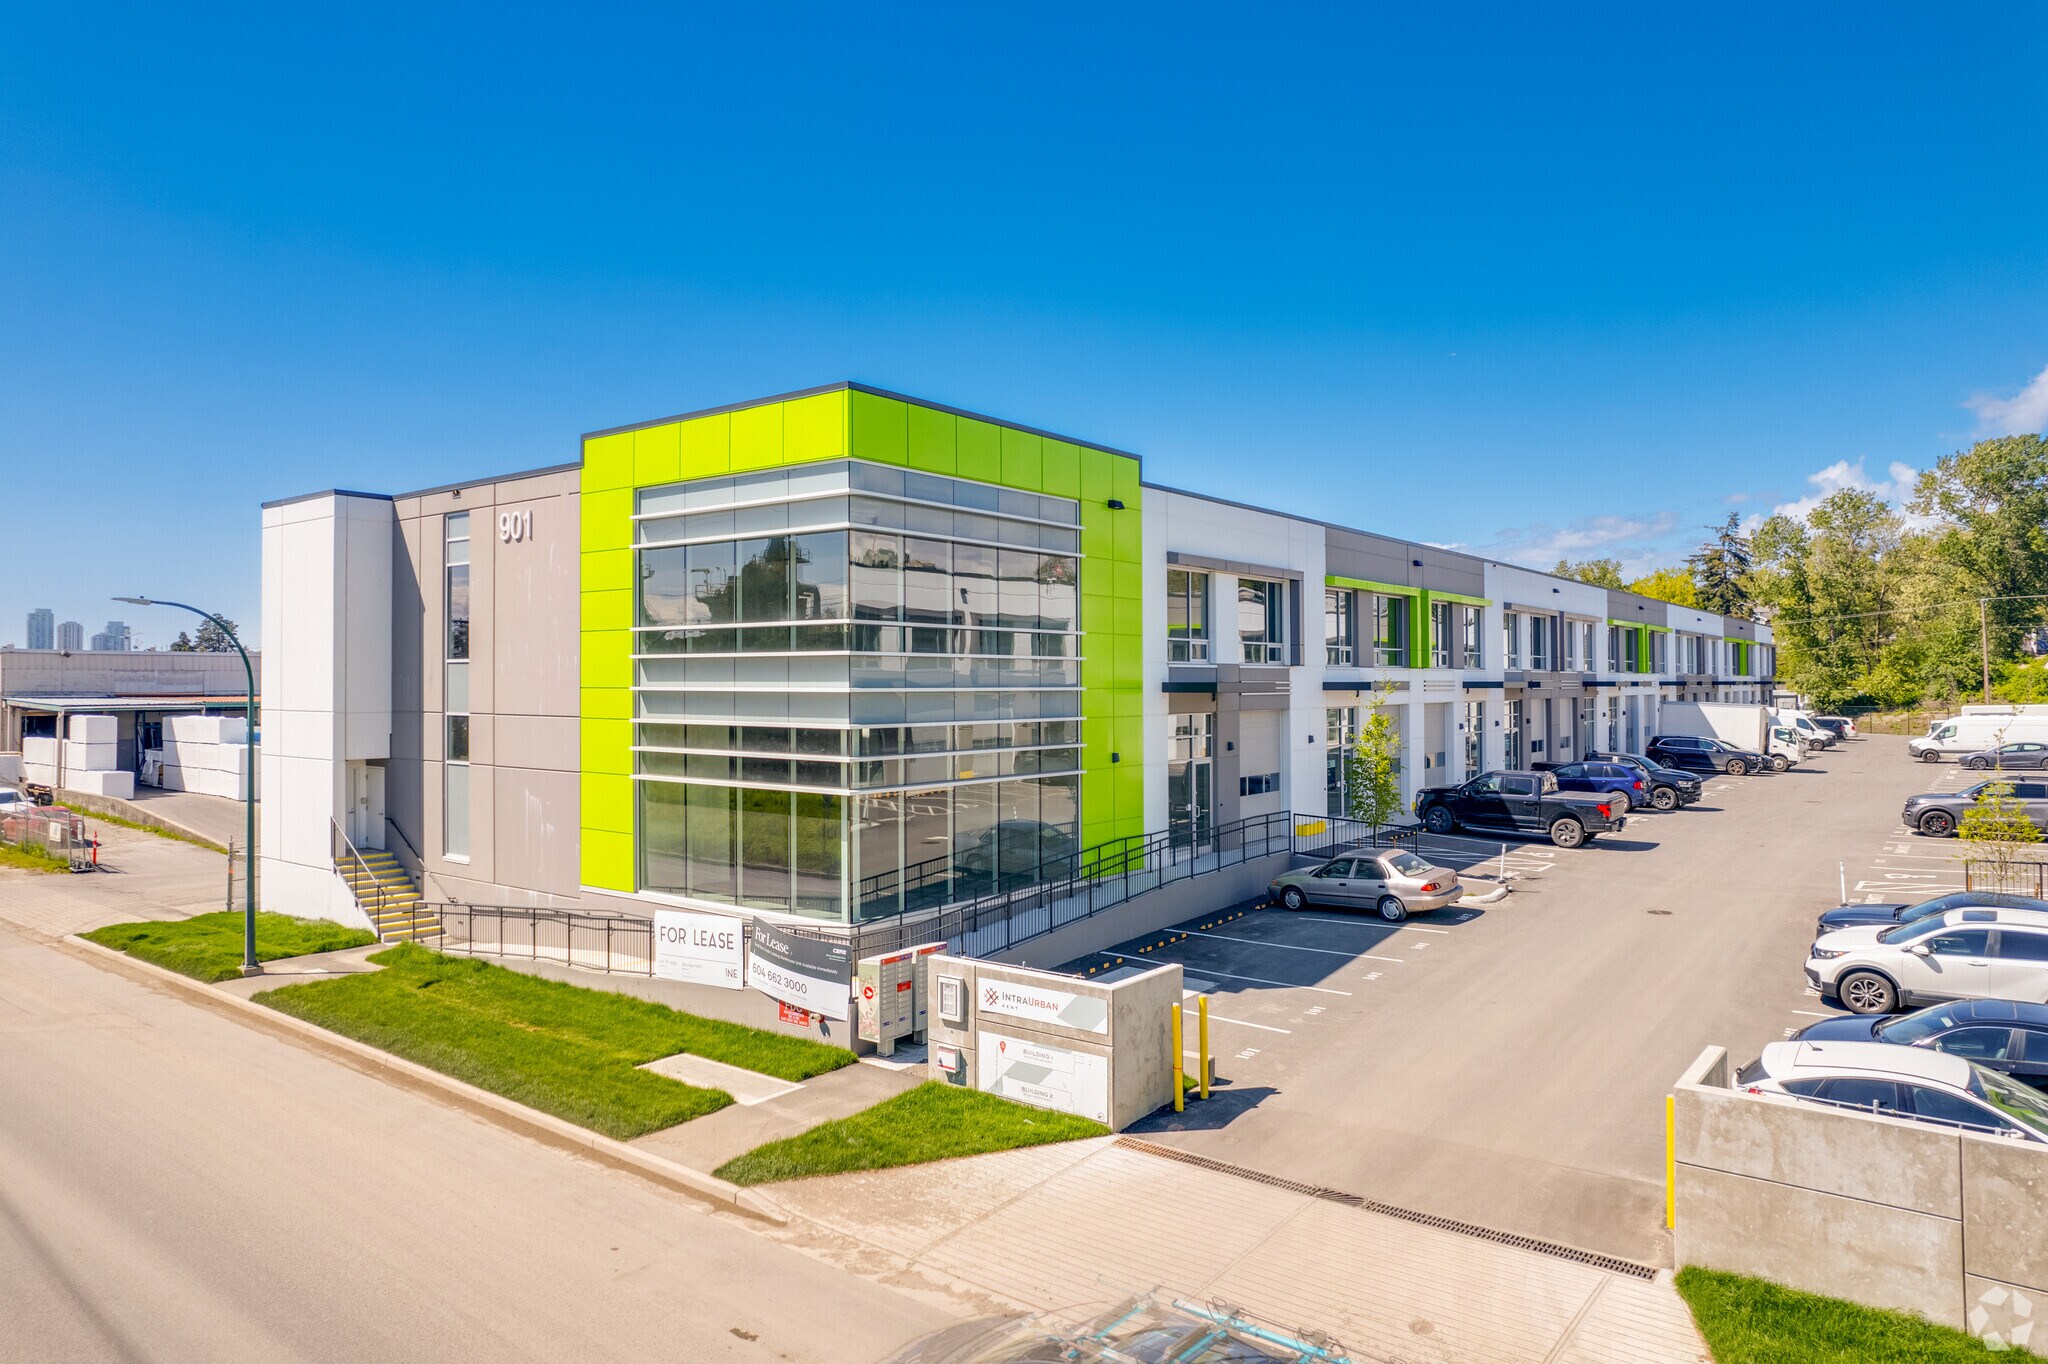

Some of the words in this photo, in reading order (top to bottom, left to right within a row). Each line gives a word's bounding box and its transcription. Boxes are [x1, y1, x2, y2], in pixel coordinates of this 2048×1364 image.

[500, 510, 531, 541] 901
[660, 926, 687, 944] FOR
[693, 929, 734, 950] LEASE
[755, 926, 767, 943] For
[766, 932, 789, 954] Lease
[752, 963, 766, 978] 604
[767, 970, 782, 985] 662
[783, 977, 807, 994] 3000
[1304, 1005, 1326, 1016] 101
[1023, 1049, 1050, 1060] BUILDING
[1235, 1047, 1261, 1060] 101
[1021, 1086, 1048, 1098] BUILDING
